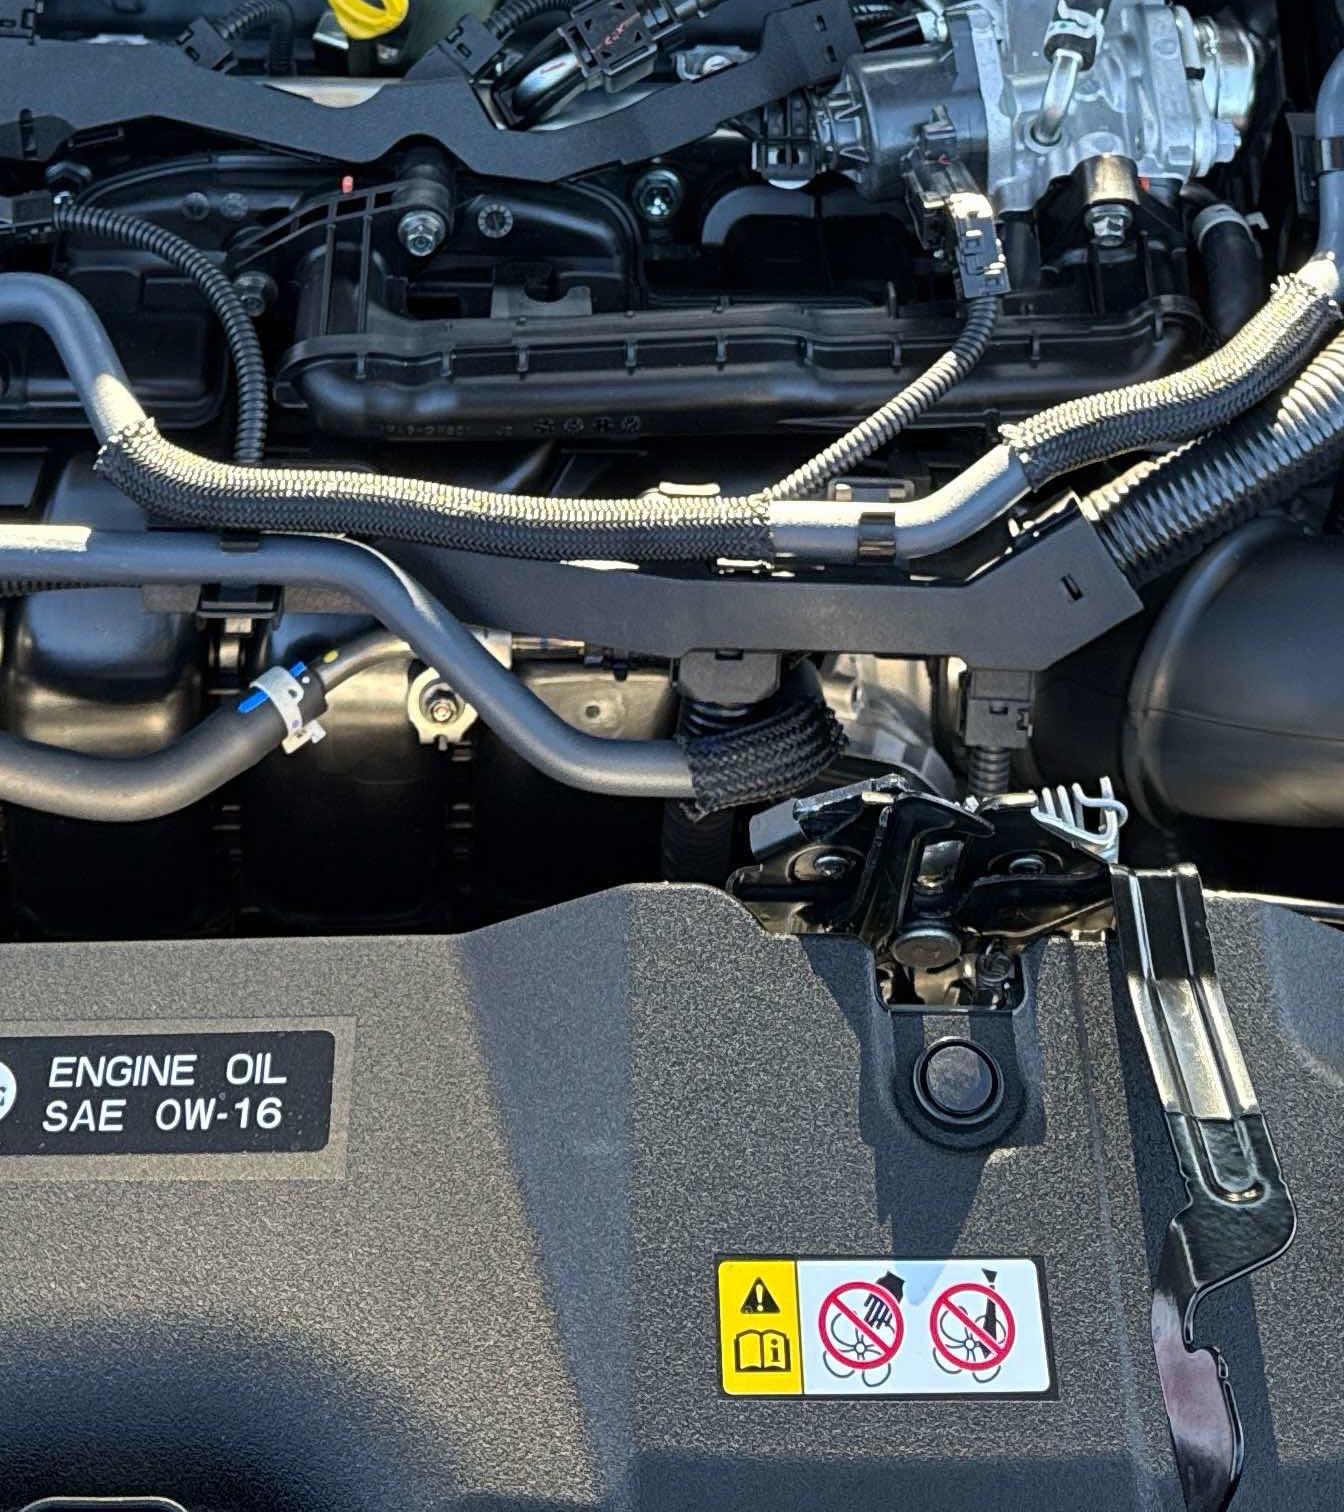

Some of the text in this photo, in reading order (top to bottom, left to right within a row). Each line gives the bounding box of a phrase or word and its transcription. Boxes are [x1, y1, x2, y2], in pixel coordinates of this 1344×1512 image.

[48, 1052, 288, 1088] ENGINE OIL
[42, 1096, 284, 1133] SAE 0W-16
